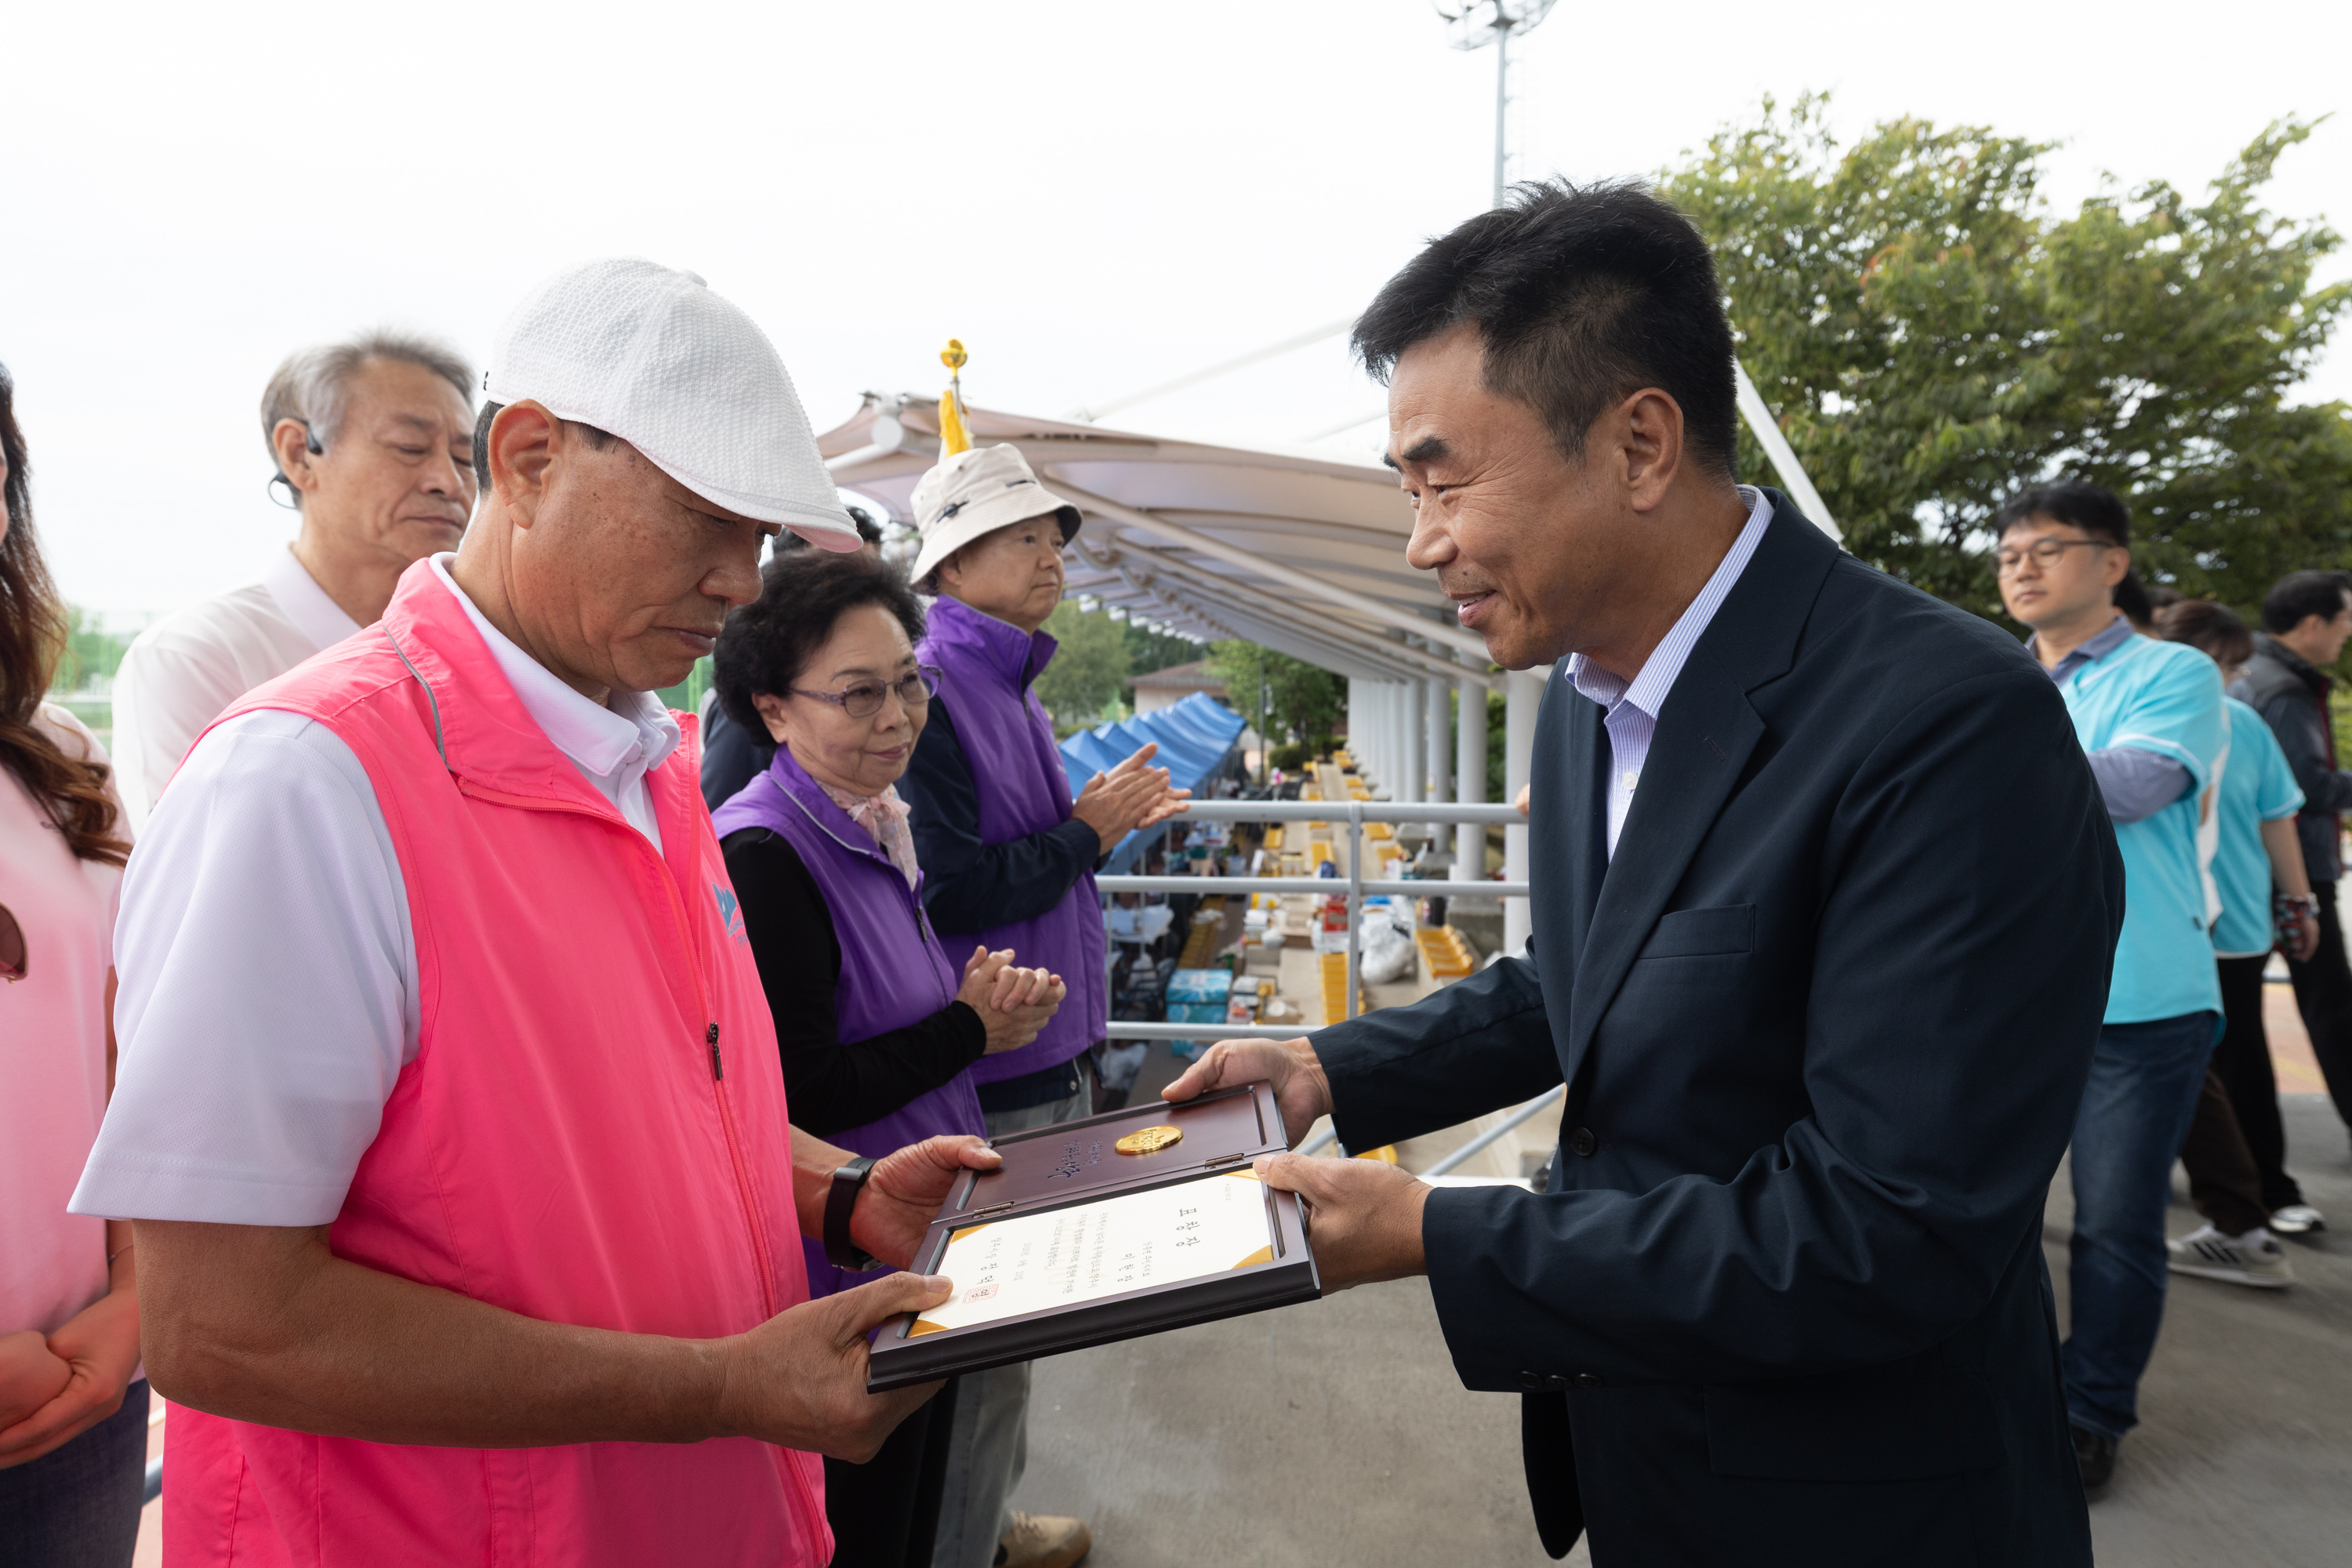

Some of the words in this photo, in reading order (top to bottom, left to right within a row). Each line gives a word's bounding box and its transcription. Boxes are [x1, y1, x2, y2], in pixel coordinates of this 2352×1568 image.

[1176, 1207, 1201, 1247] 표창장
[1094, 1231, 1105, 1245] 남다른
[1088, 1273, 1101, 1289] 양주시
